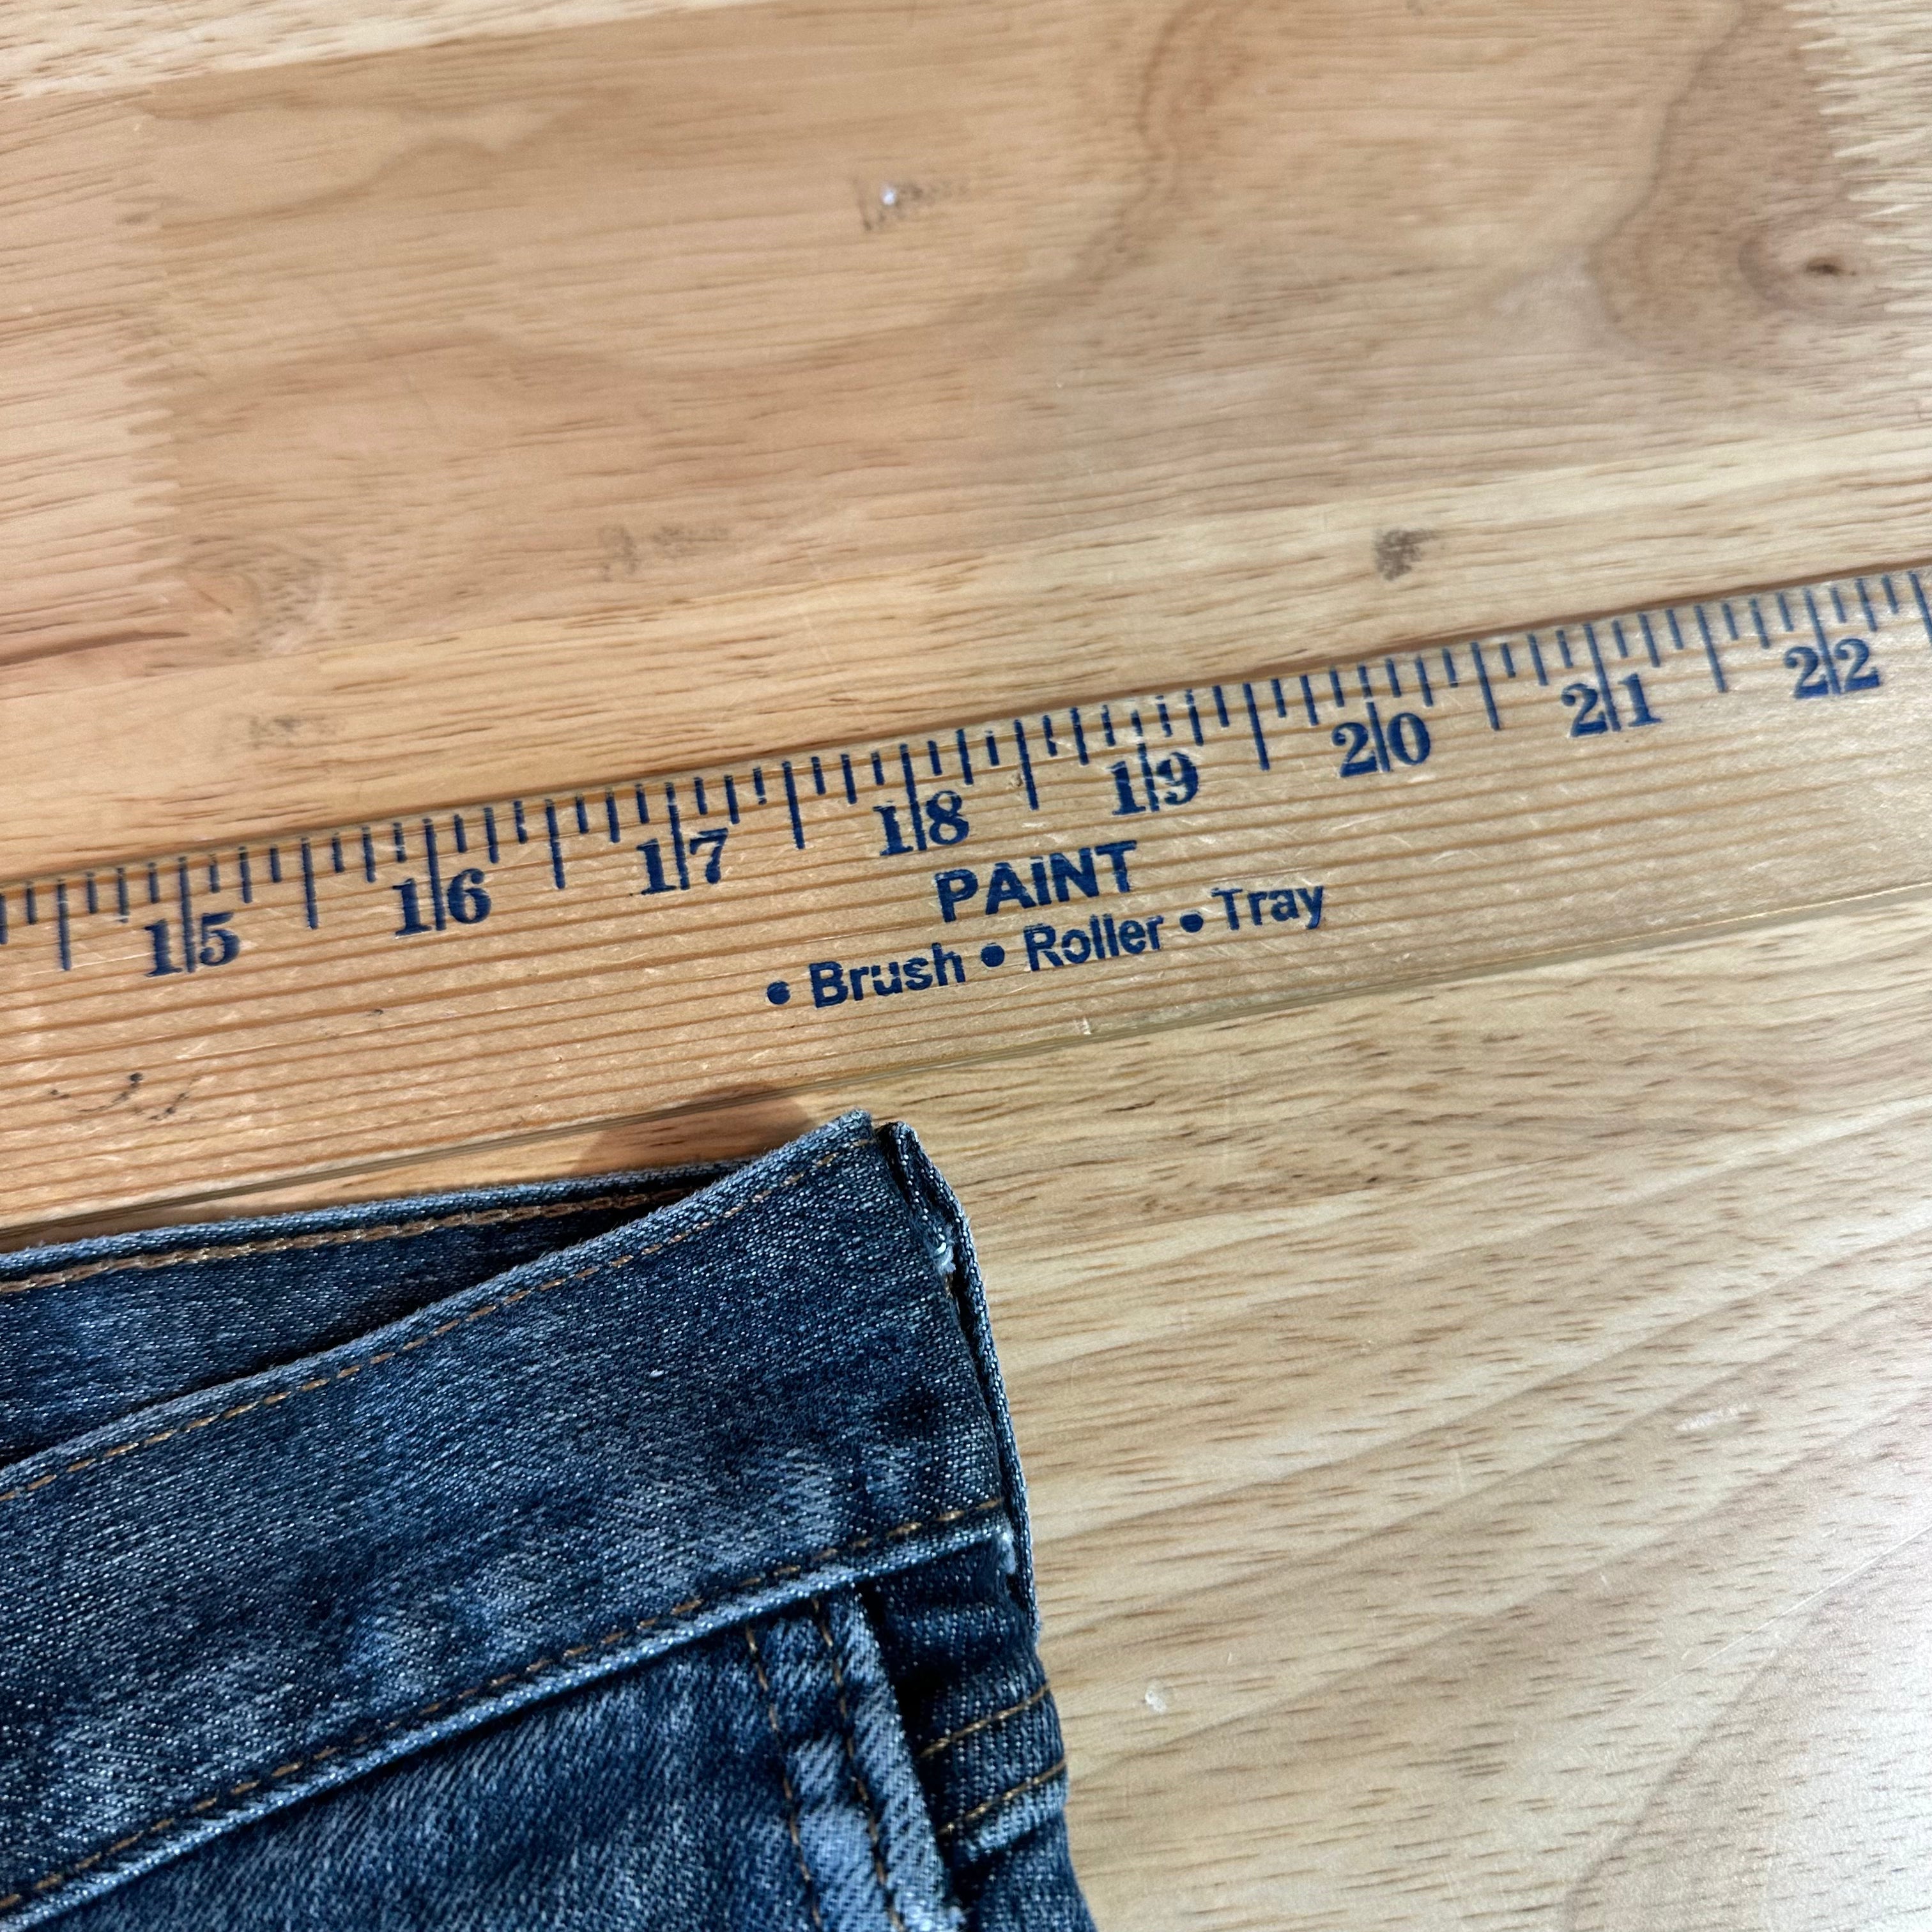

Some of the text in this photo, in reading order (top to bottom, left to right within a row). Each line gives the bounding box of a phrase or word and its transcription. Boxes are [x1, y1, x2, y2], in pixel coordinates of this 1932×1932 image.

[145, 638, 1880, 977] 15 16 17 18 19 20 21 22
[934, 840, 1137, 922] PAINT
[809, 885, 1324, 1008] Brush Roller Tray
